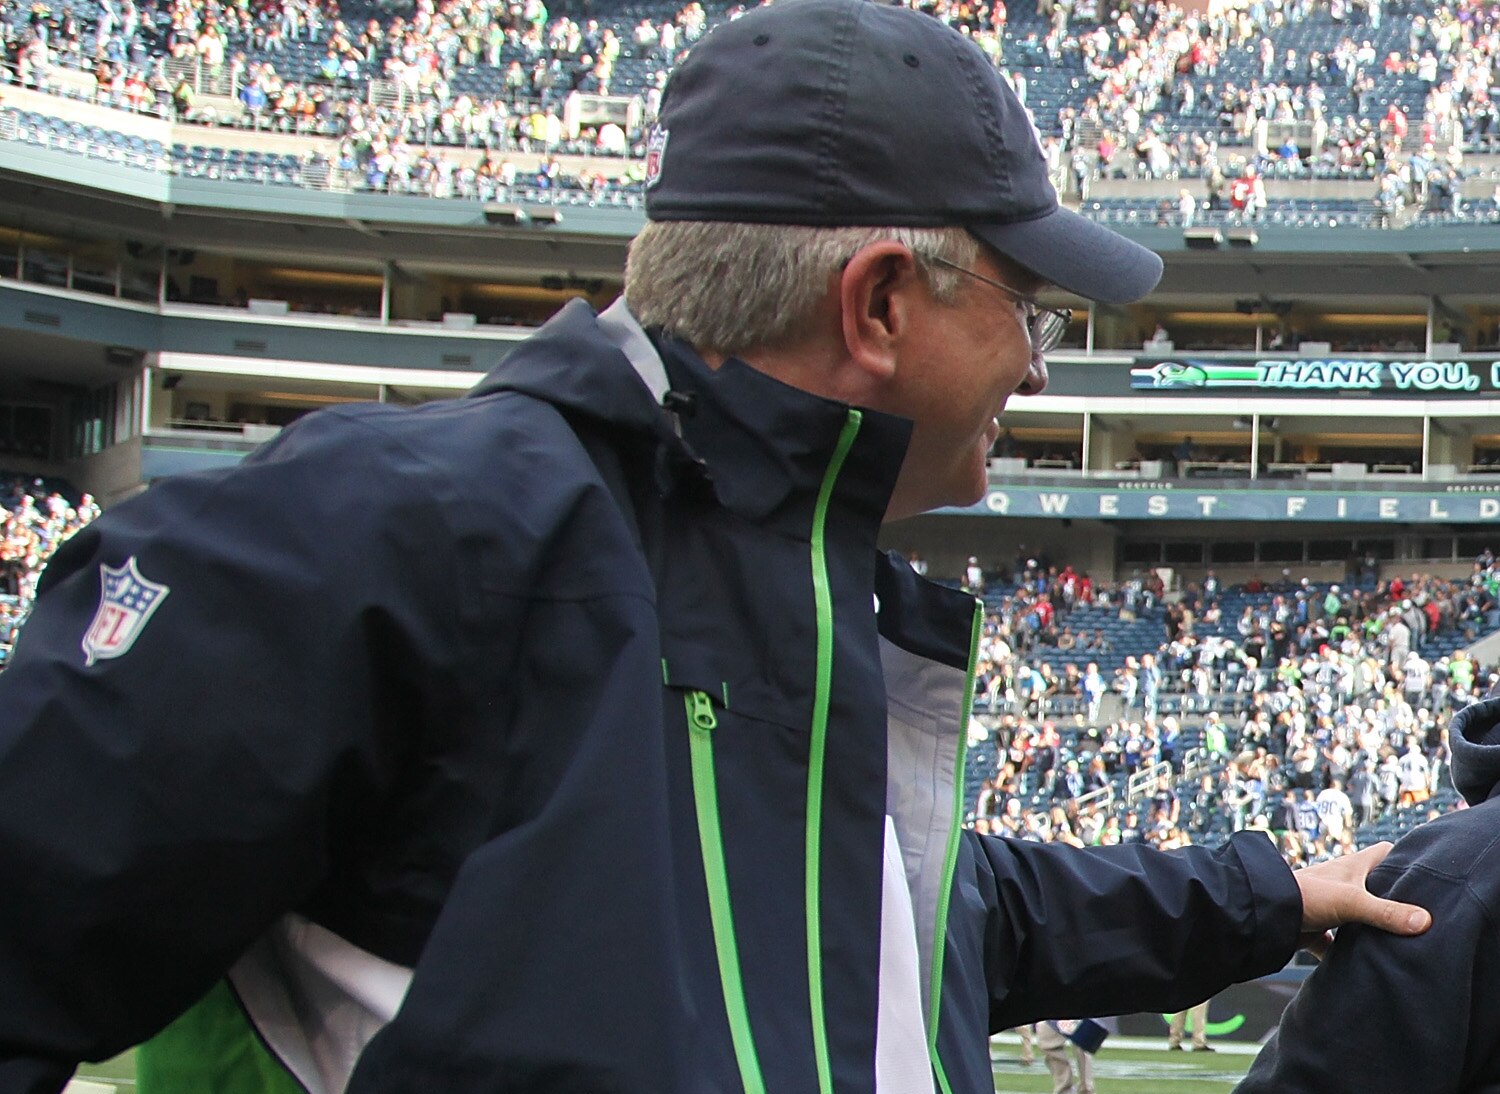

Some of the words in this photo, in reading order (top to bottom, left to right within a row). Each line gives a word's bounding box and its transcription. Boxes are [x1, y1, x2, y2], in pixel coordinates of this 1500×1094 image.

[1257, 361, 1382, 388] THANK
[1390, 361, 1479, 390] YOU,
[987, 492, 1218, 516] QWEST
[1287, 497, 1500, 519] FIELD
